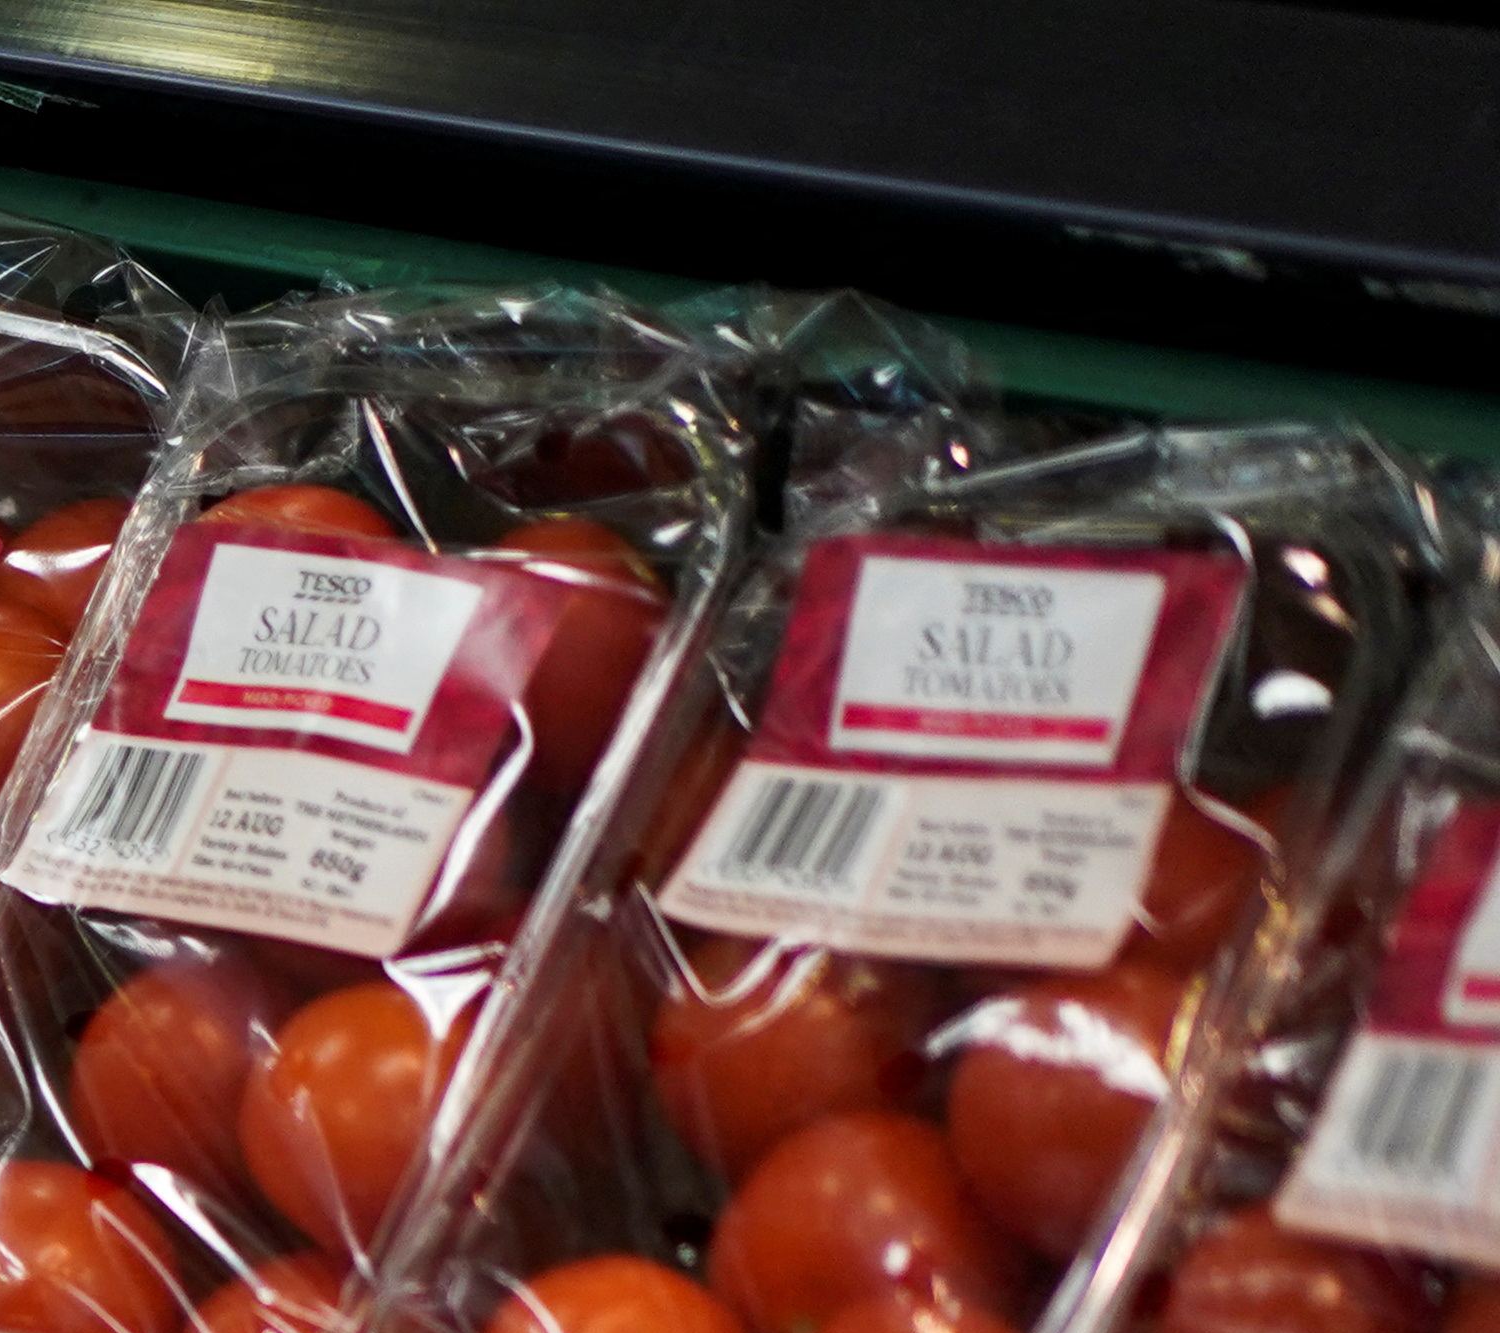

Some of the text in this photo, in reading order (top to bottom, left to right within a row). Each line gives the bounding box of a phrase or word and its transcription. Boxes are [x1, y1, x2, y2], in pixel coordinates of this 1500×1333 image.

[297, 569, 373, 597] TESCO
[254, 605, 381, 652] SALAD
[238, 647, 375, 686] TOMATOES
[234, 810, 285, 838] AUG
